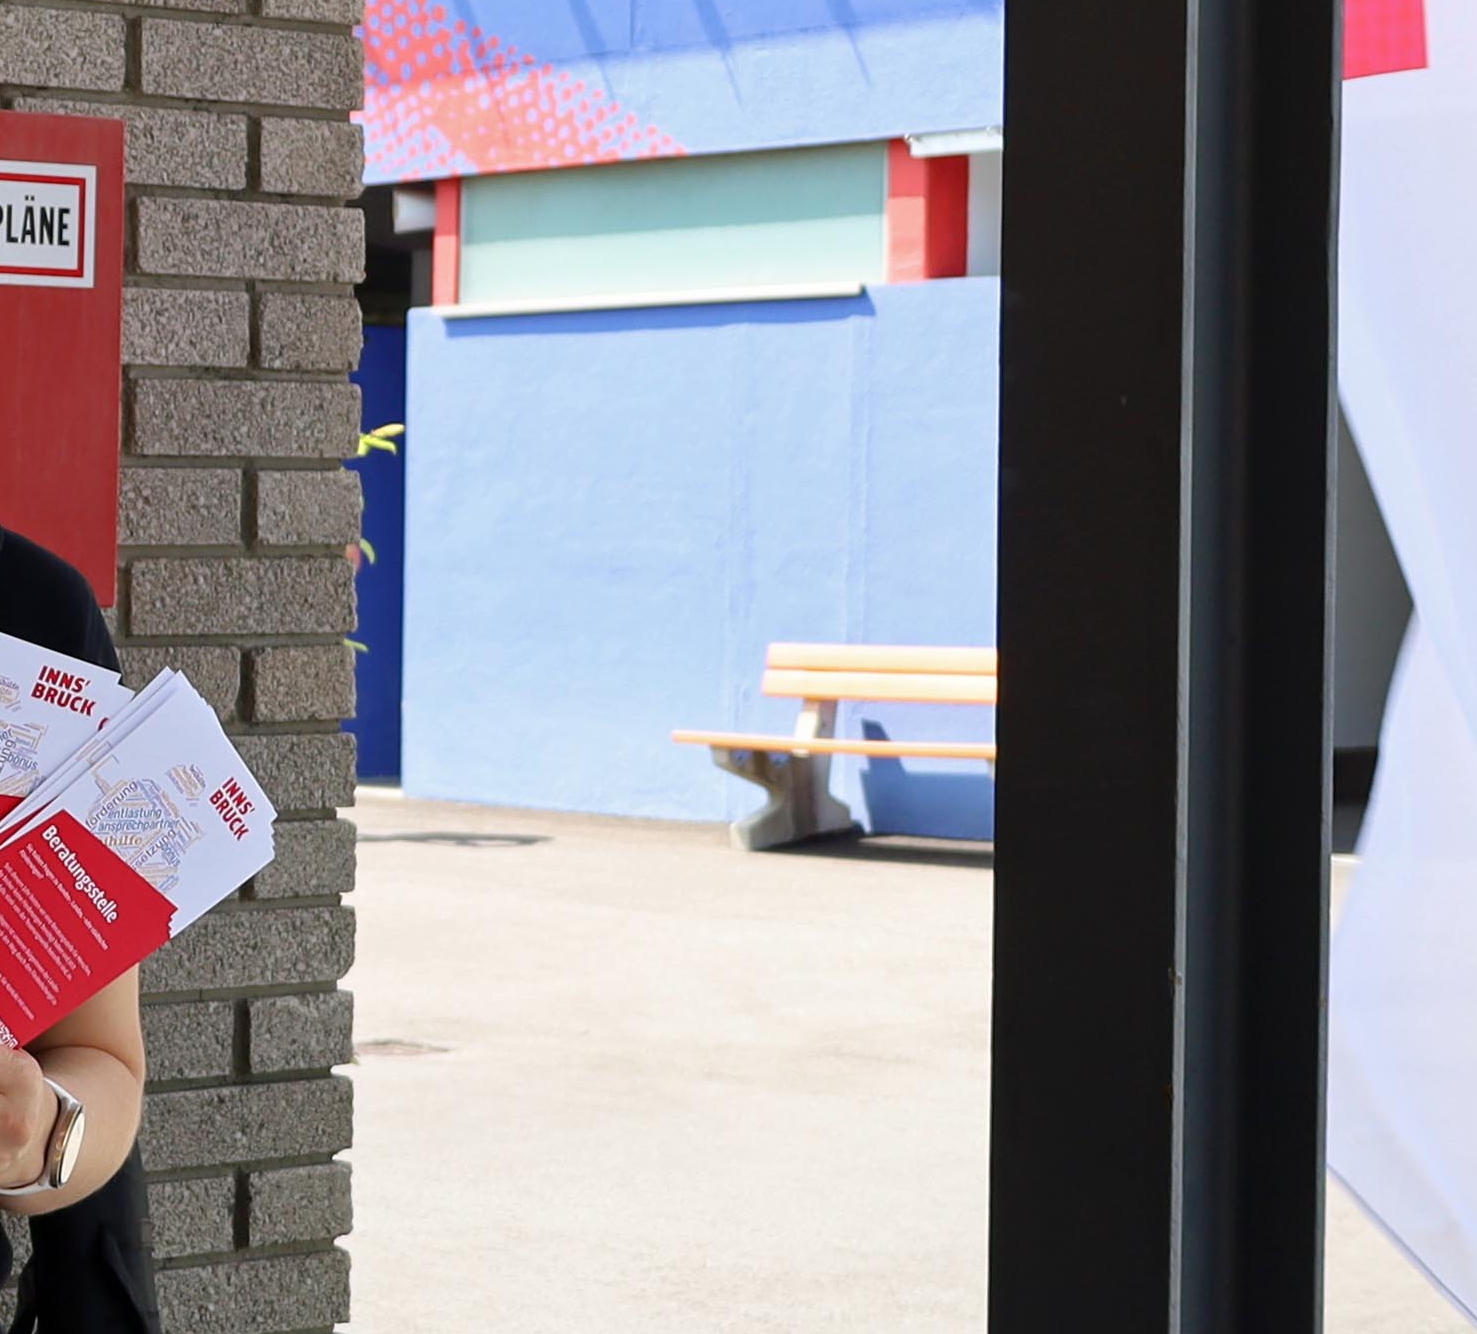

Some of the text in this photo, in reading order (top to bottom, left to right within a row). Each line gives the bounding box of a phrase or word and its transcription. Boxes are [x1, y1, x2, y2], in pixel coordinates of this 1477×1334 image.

[38, 665, 91, 693] INNS'
[31, 681, 96, 717] BRUCK
[209, 789, 249, 841] BRUCK
[222, 777, 255, 816] INNS'
[44, 824, 118, 923] Beratungsstelle
